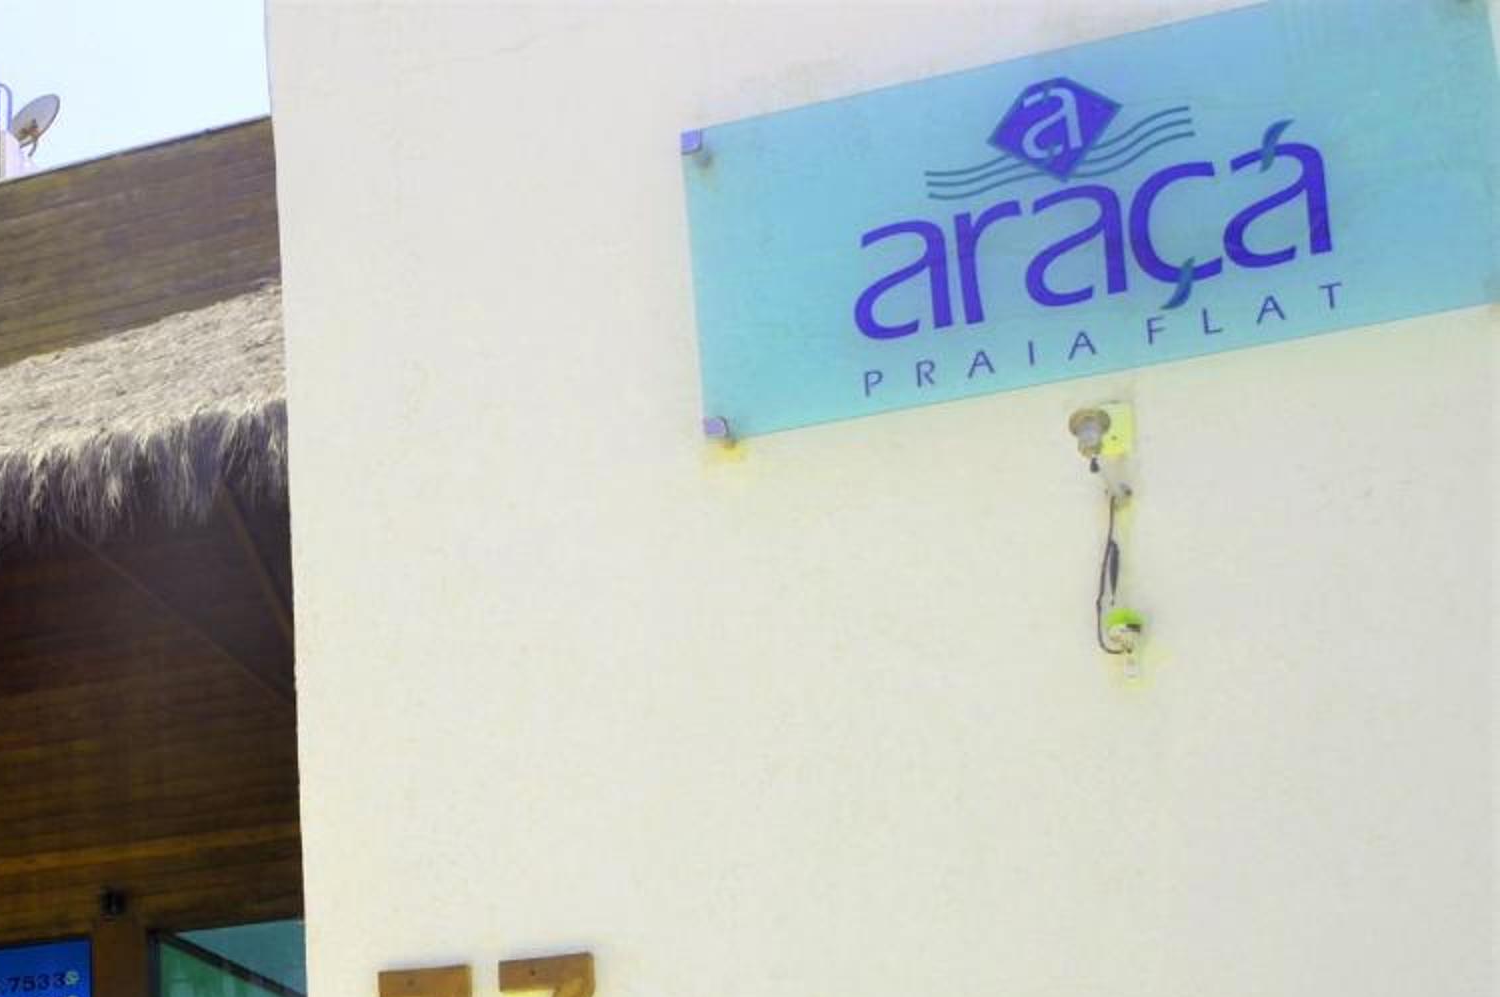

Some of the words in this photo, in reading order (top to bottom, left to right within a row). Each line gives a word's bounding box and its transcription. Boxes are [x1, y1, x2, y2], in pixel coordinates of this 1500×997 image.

[853, 119, 1334, 341] araçá
[863, 330, 1098, 397] PRAIA
[1145, 282, 1343, 345] FLAT
